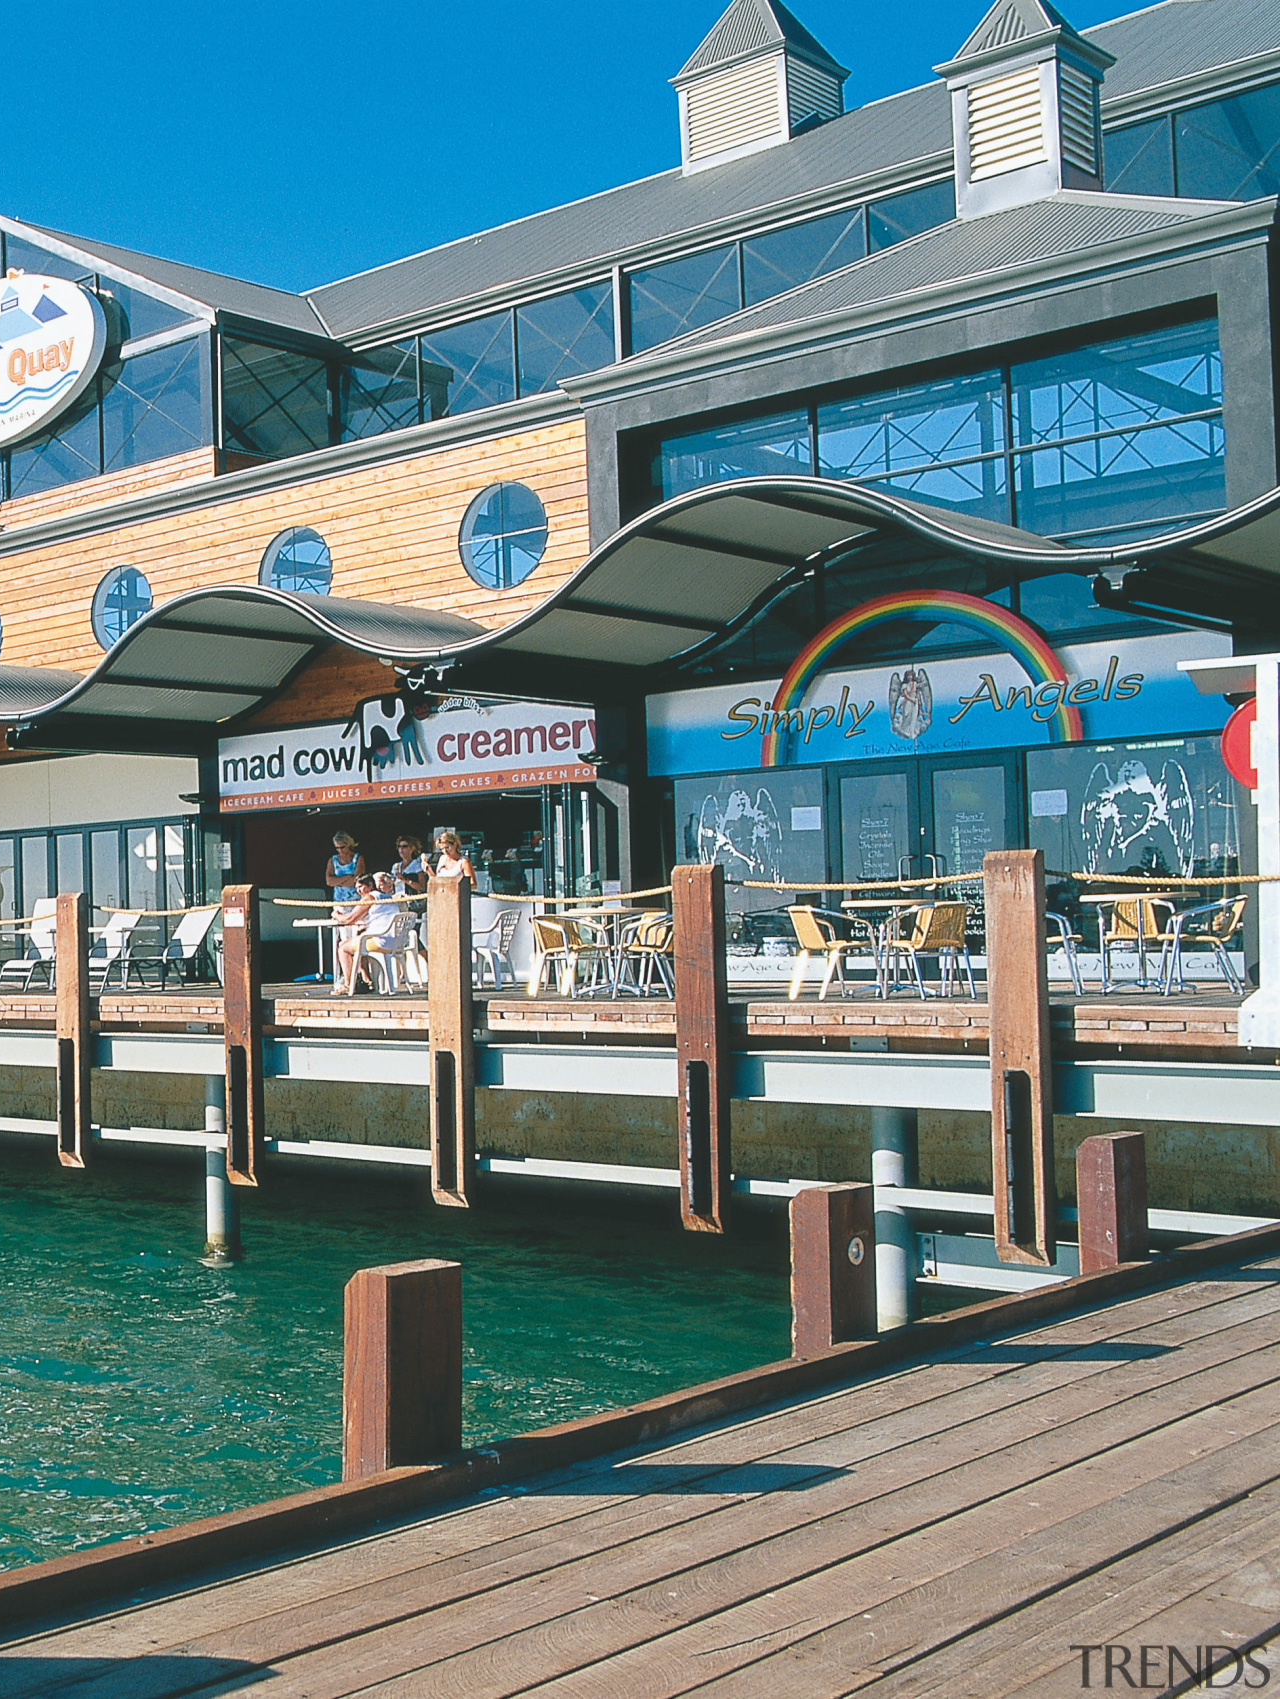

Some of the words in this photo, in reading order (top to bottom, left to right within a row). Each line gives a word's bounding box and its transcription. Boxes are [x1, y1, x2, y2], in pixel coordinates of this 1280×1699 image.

[7, 336, 75, 386] Quay
[9, 408, 37, 423] MARINA
[437, 697, 463, 714] udder
[720, 685, 875, 744] Simply
[948, 655, 1144, 724] Angels
[862, 744, 885, 756] The
[887, 742, 913, 754] New
[916, 740, 939, 753] Age
[222, 744, 285, 784] mad
[292, 745, 357, 777] cow
[223, 796, 274, 808] ICECREAM
[277, 792, 305, 803] CAFE
[321, 787, 361, 801] JUICES
[380, 781, 432, 795] COFFEES
[450, 775, 492, 789] CAKES
[965, 916, 983, 926] Tea
